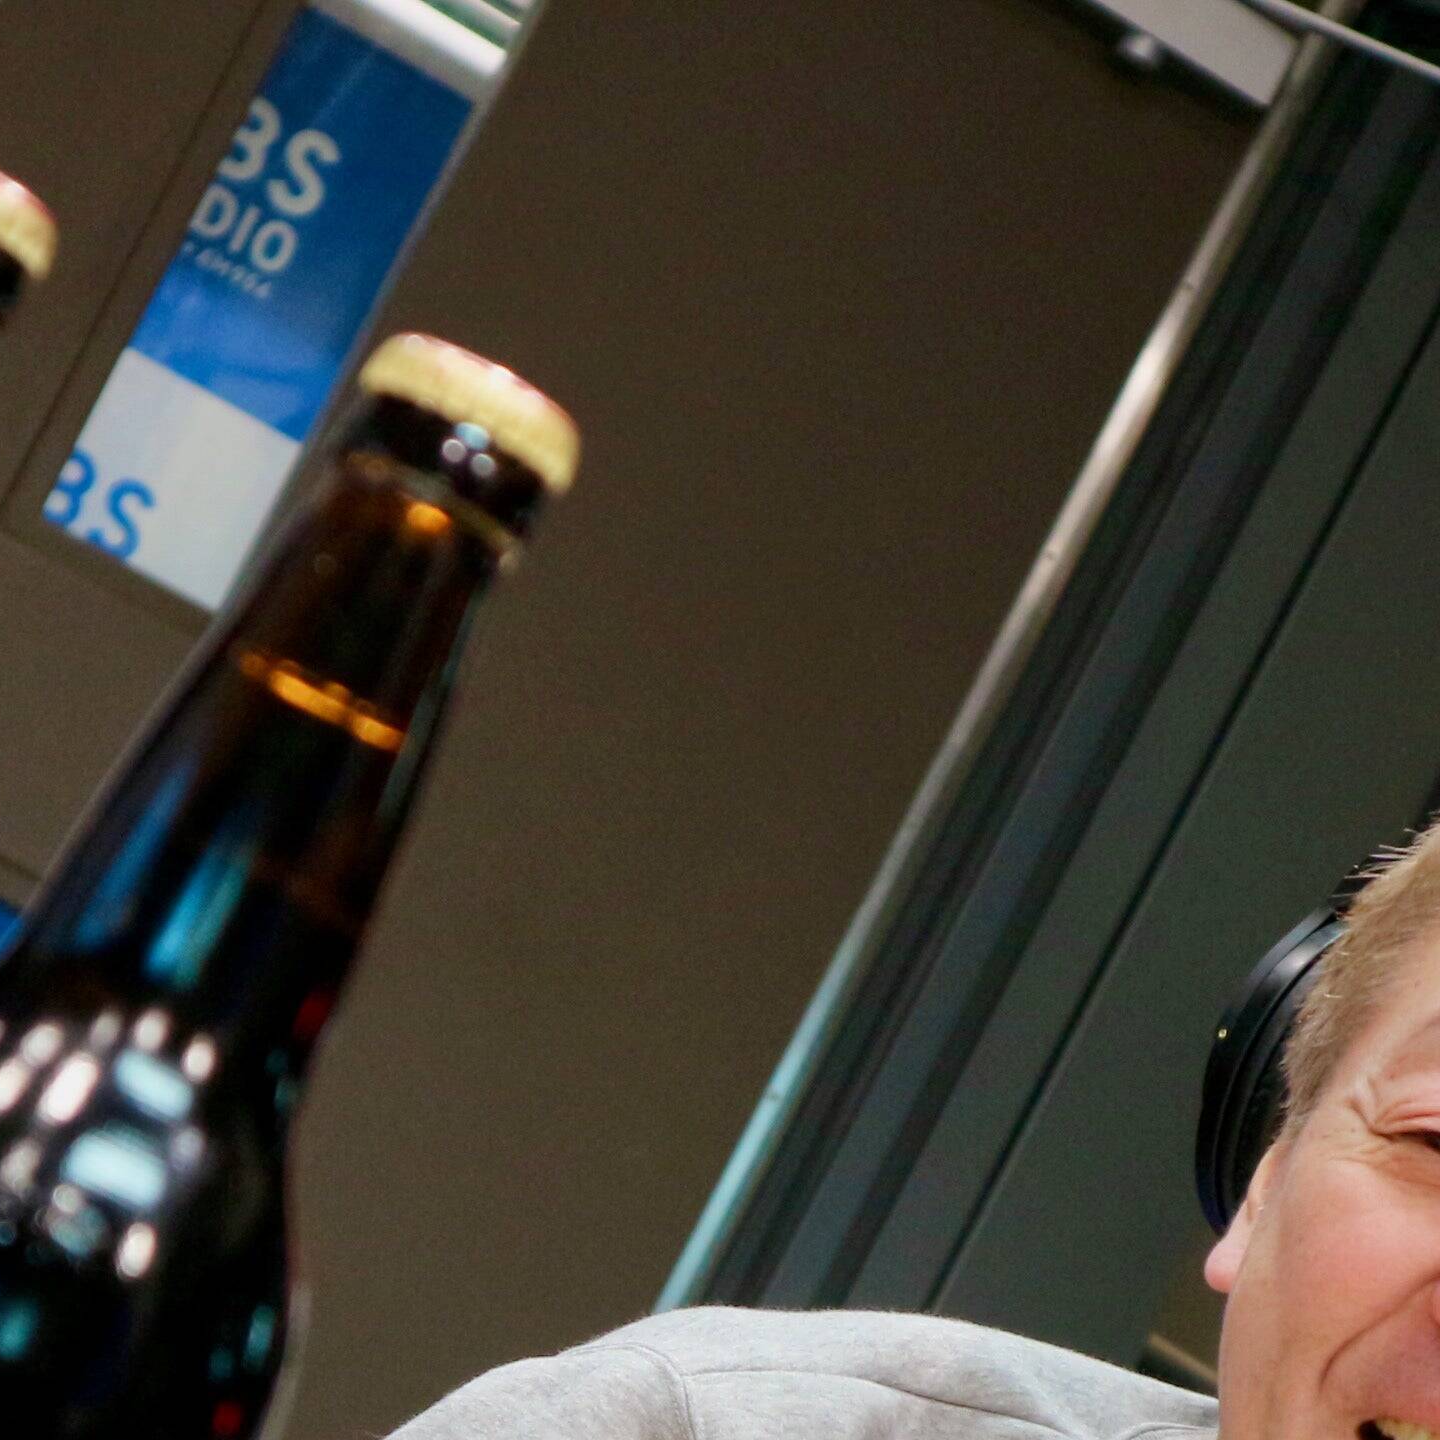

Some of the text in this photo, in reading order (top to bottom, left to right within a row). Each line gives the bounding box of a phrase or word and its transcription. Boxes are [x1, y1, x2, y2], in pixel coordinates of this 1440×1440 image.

[218, 97, 340, 216] BS
[190, 184, 298, 273] DIO
[42, 447, 156, 562] BS
